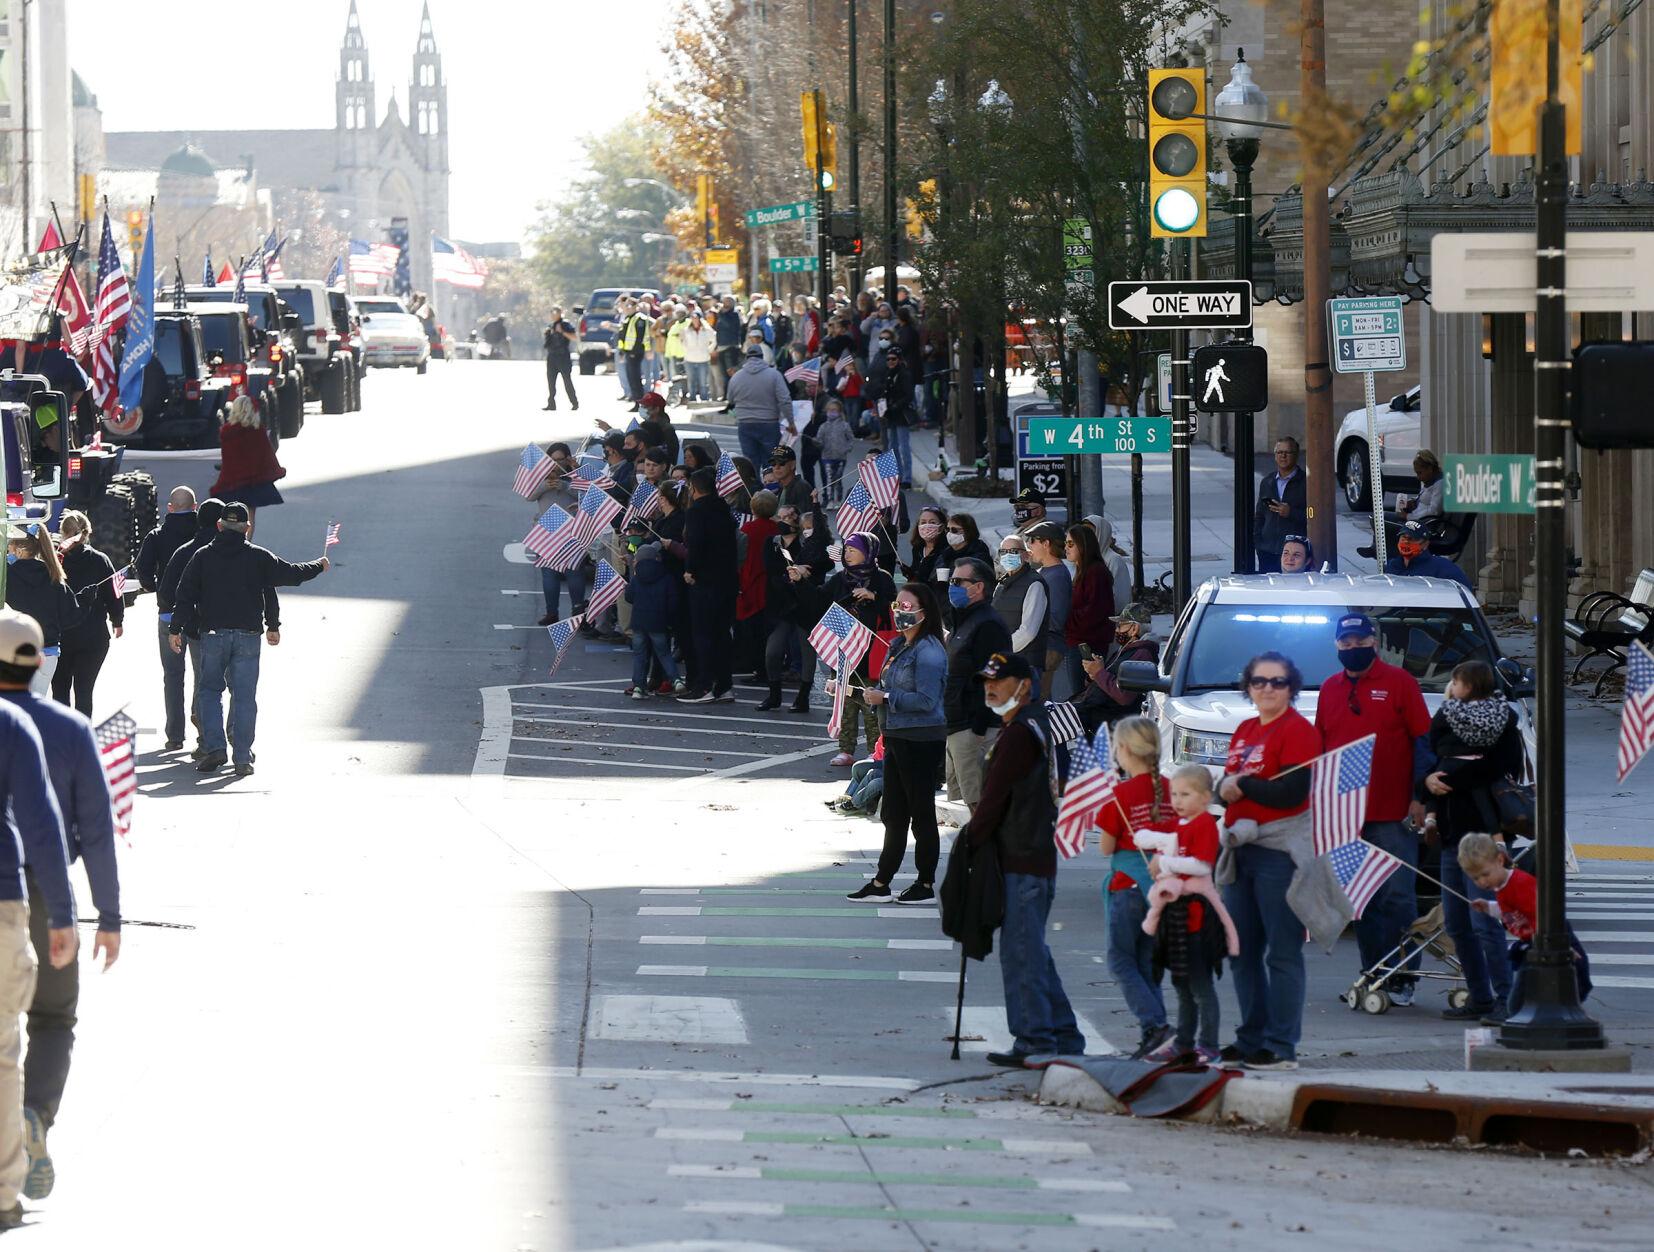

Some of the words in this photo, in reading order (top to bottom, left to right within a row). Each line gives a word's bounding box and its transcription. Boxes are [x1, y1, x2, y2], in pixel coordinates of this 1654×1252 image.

[756, 208, 792, 223] Boulder
[796, 204, 805, 216] W
[1152, 296, 1189, 313] ONE
[1197, 295, 1235, 313] WAY
[1341, 319, 1349, 331] P
[1386, 317, 1392, 329] 2
[1044, 429, 1056, 444] W
[1068, 423, 1104, 449] 4th
[1117, 420, 1132, 435] St
[1146, 428, 1156, 443] S
[1114, 438, 1136, 452] 100
[1023, 462, 1050, 472] Parking
[1033, 473, 1060, 493] $2
[1445, 472, 1452, 496] S
[1456, 463, 1503, 504] Boulder
[1509, 463, 1522, 503] W
